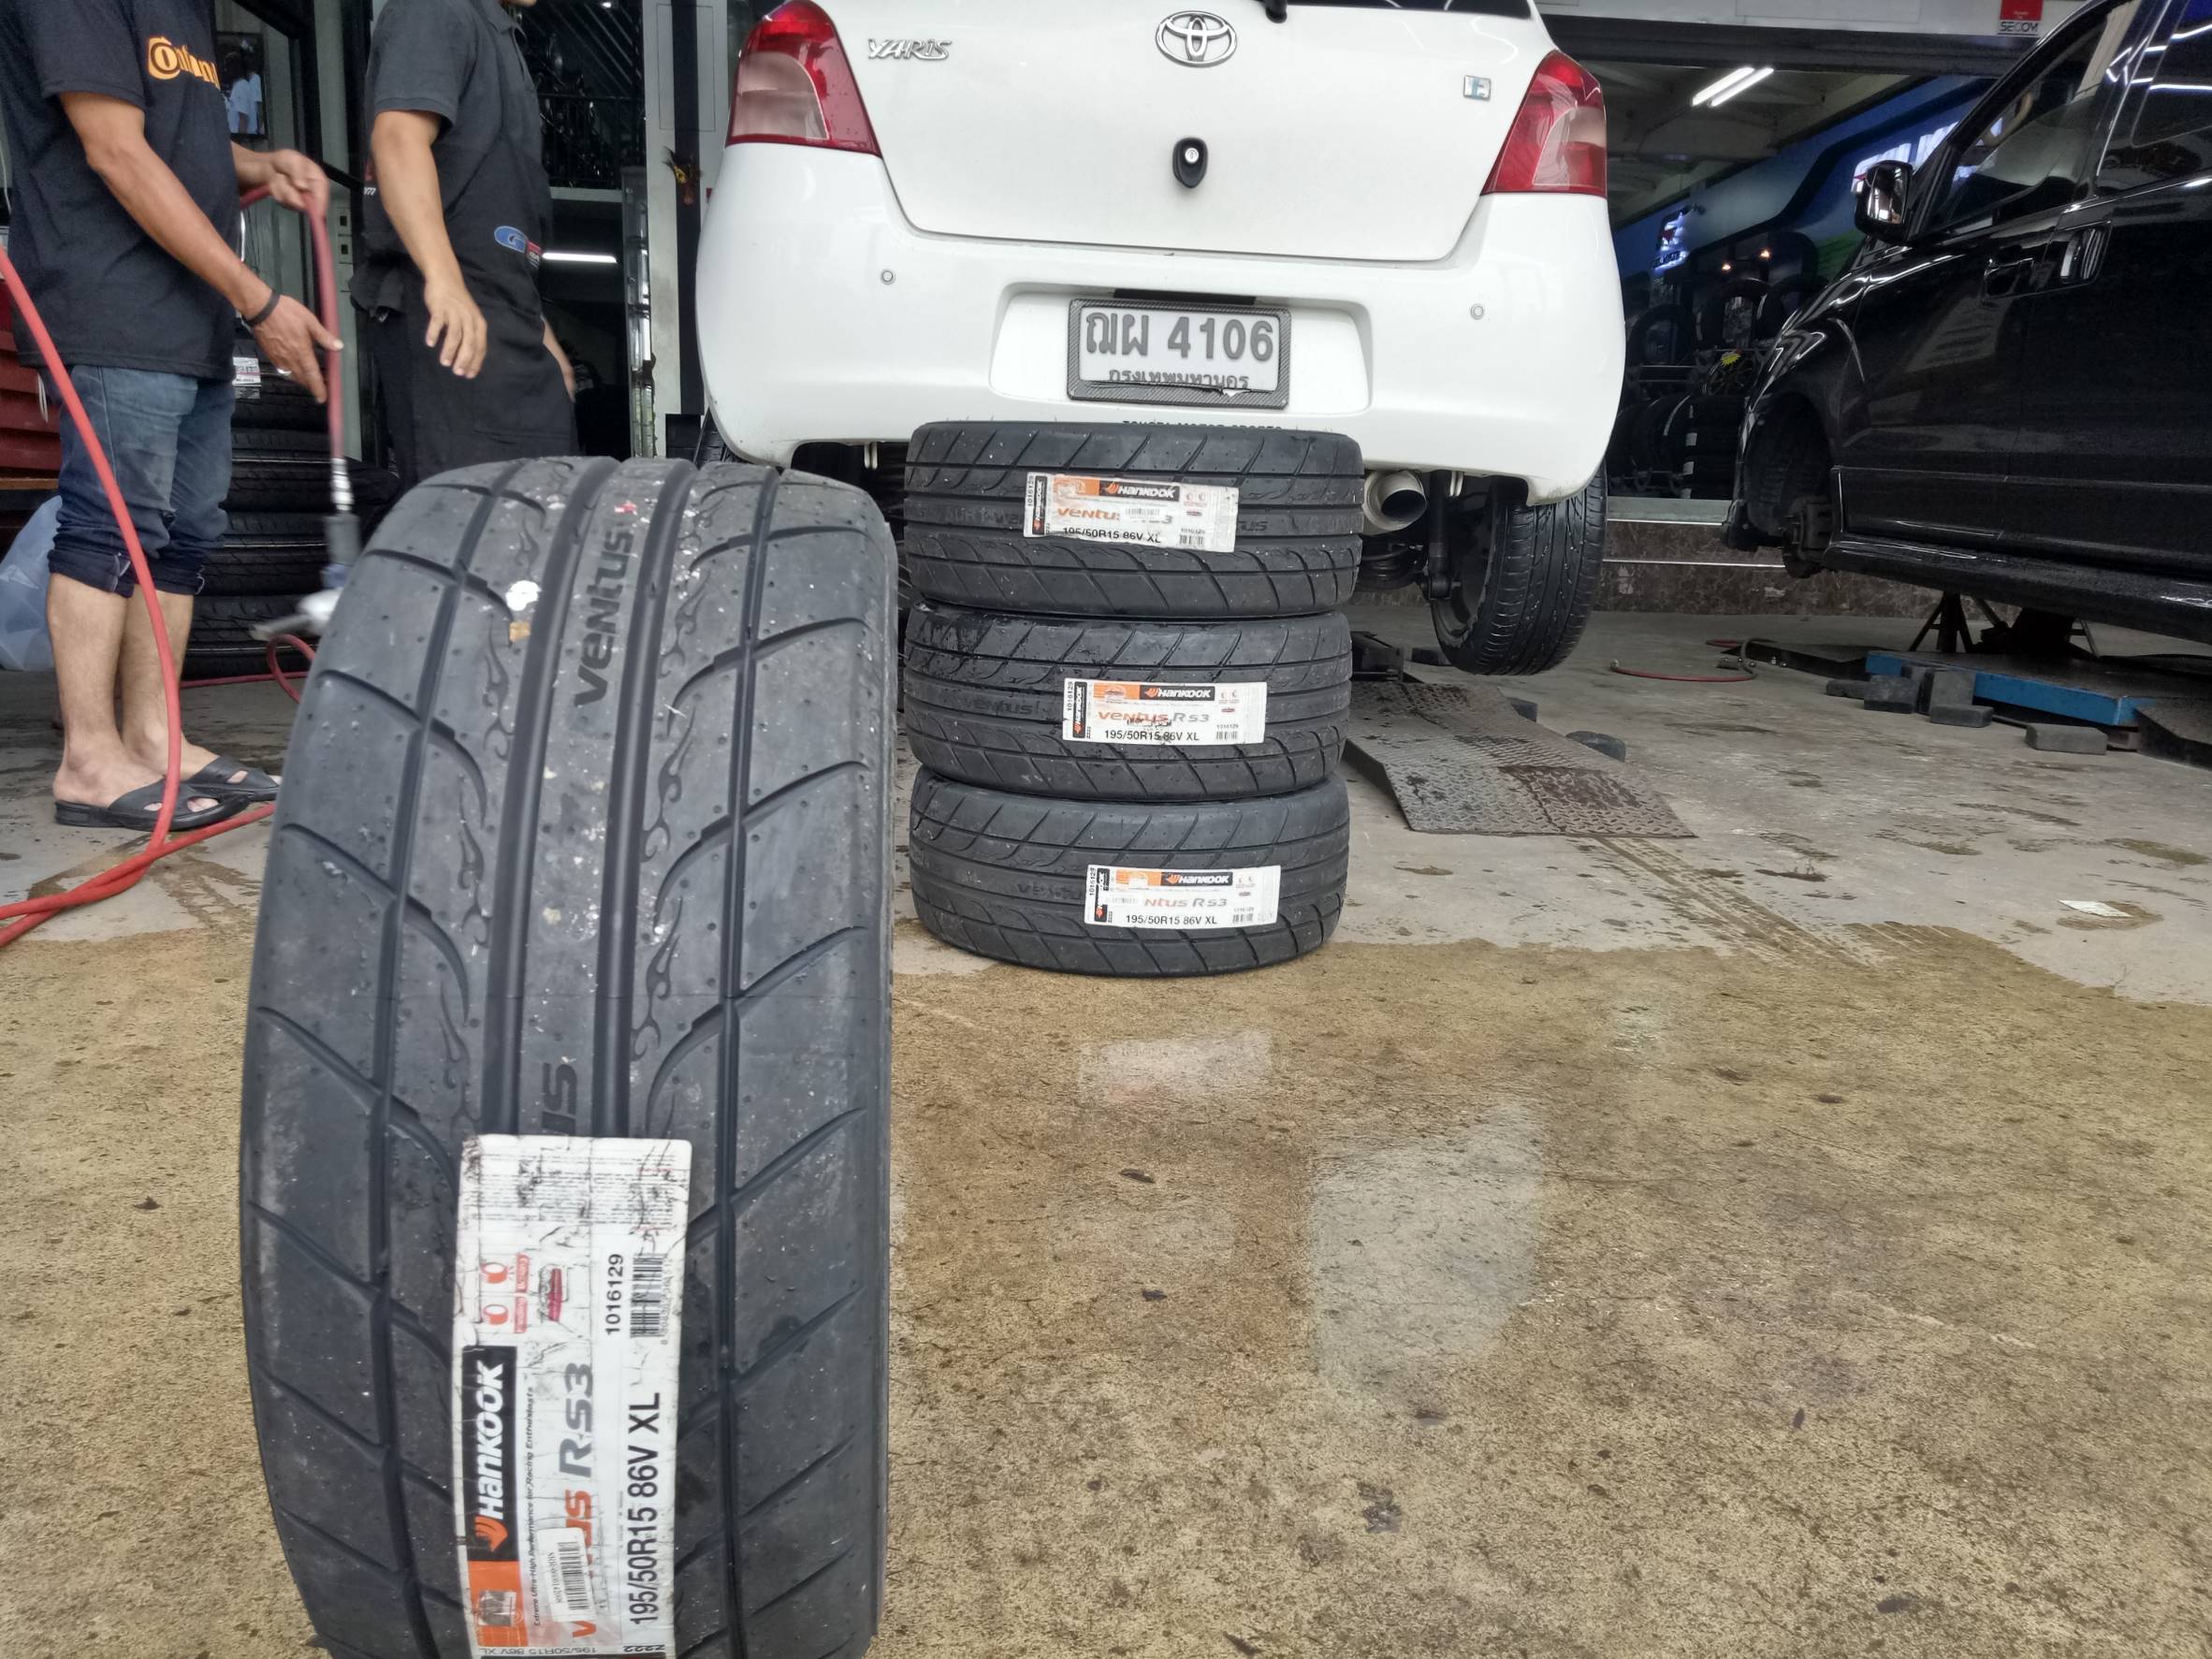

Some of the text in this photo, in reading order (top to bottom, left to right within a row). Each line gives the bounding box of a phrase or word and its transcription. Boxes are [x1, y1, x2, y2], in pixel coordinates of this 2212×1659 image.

[1999, 22, 2038, 32] SECOM
[867, 38, 953, 61] YARIS
[1168, 316, 1273, 361] 4106
[1109, 369, 1249, 389] กรงเทพมหานคร
[1057, 508, 1121, 521] Ventu
[1063, 527, 1119, 540] 195/50R15
[1123, 532, 1143, 542] 86V
[1146, 531, 1161, 544] XL
[1105, 730, 1200, 741] 195/50R15 86V XL
[1088, 866, 1097, 896] 1016129
[1144, 897, 1188, 908] ntus
[1126, 914, 1217, 925] 195/50R15 86V XL
[604, 1254, 624, 1335] 1016129
[560, 1362, 593, 1477] RS3
[627, 1392, 661, 1625] 195/50R15 86V XL
[623, 1644, 665, 1652] Z222
